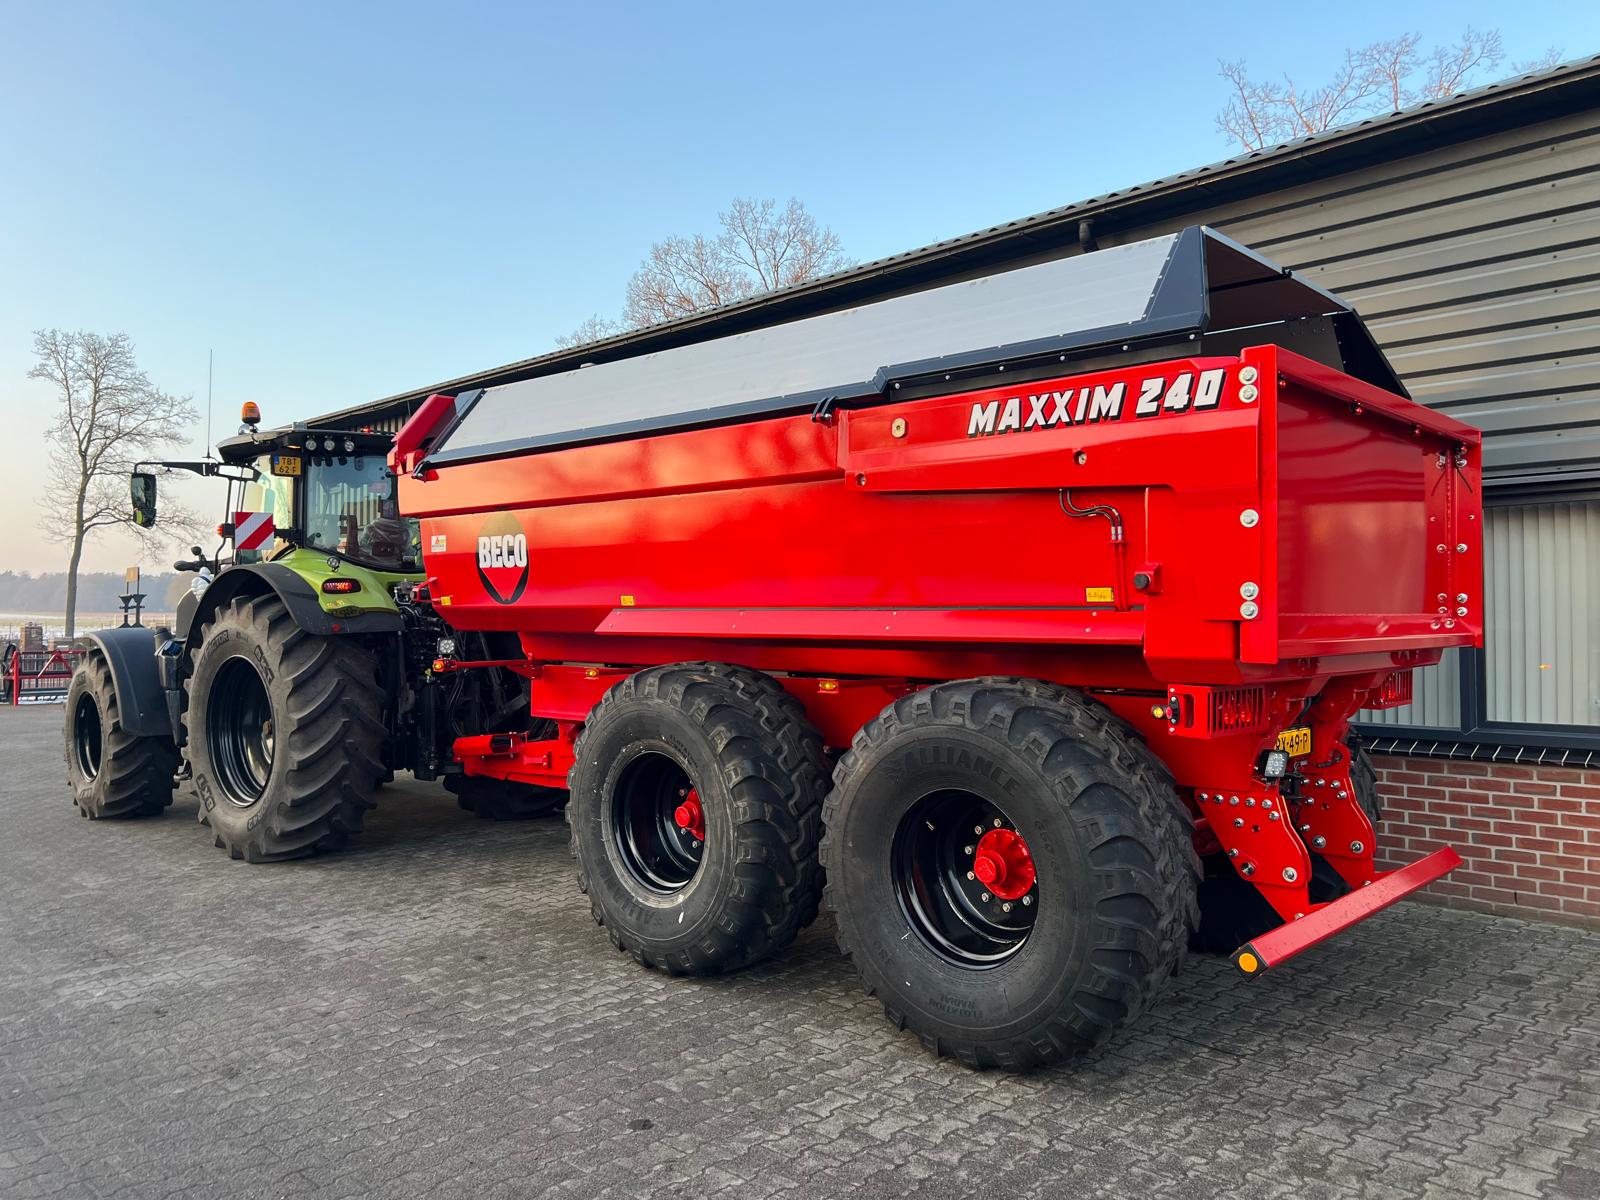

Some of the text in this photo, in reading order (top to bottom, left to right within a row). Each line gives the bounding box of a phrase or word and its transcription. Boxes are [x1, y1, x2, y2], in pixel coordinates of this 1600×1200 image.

[967, 367, 1228, 439] MAXXIM 240
[478, 533, 528, 568] BECO
[195, 773, 216, 813] BKT
[899, 745, 1022, 798] ALLIANCE
